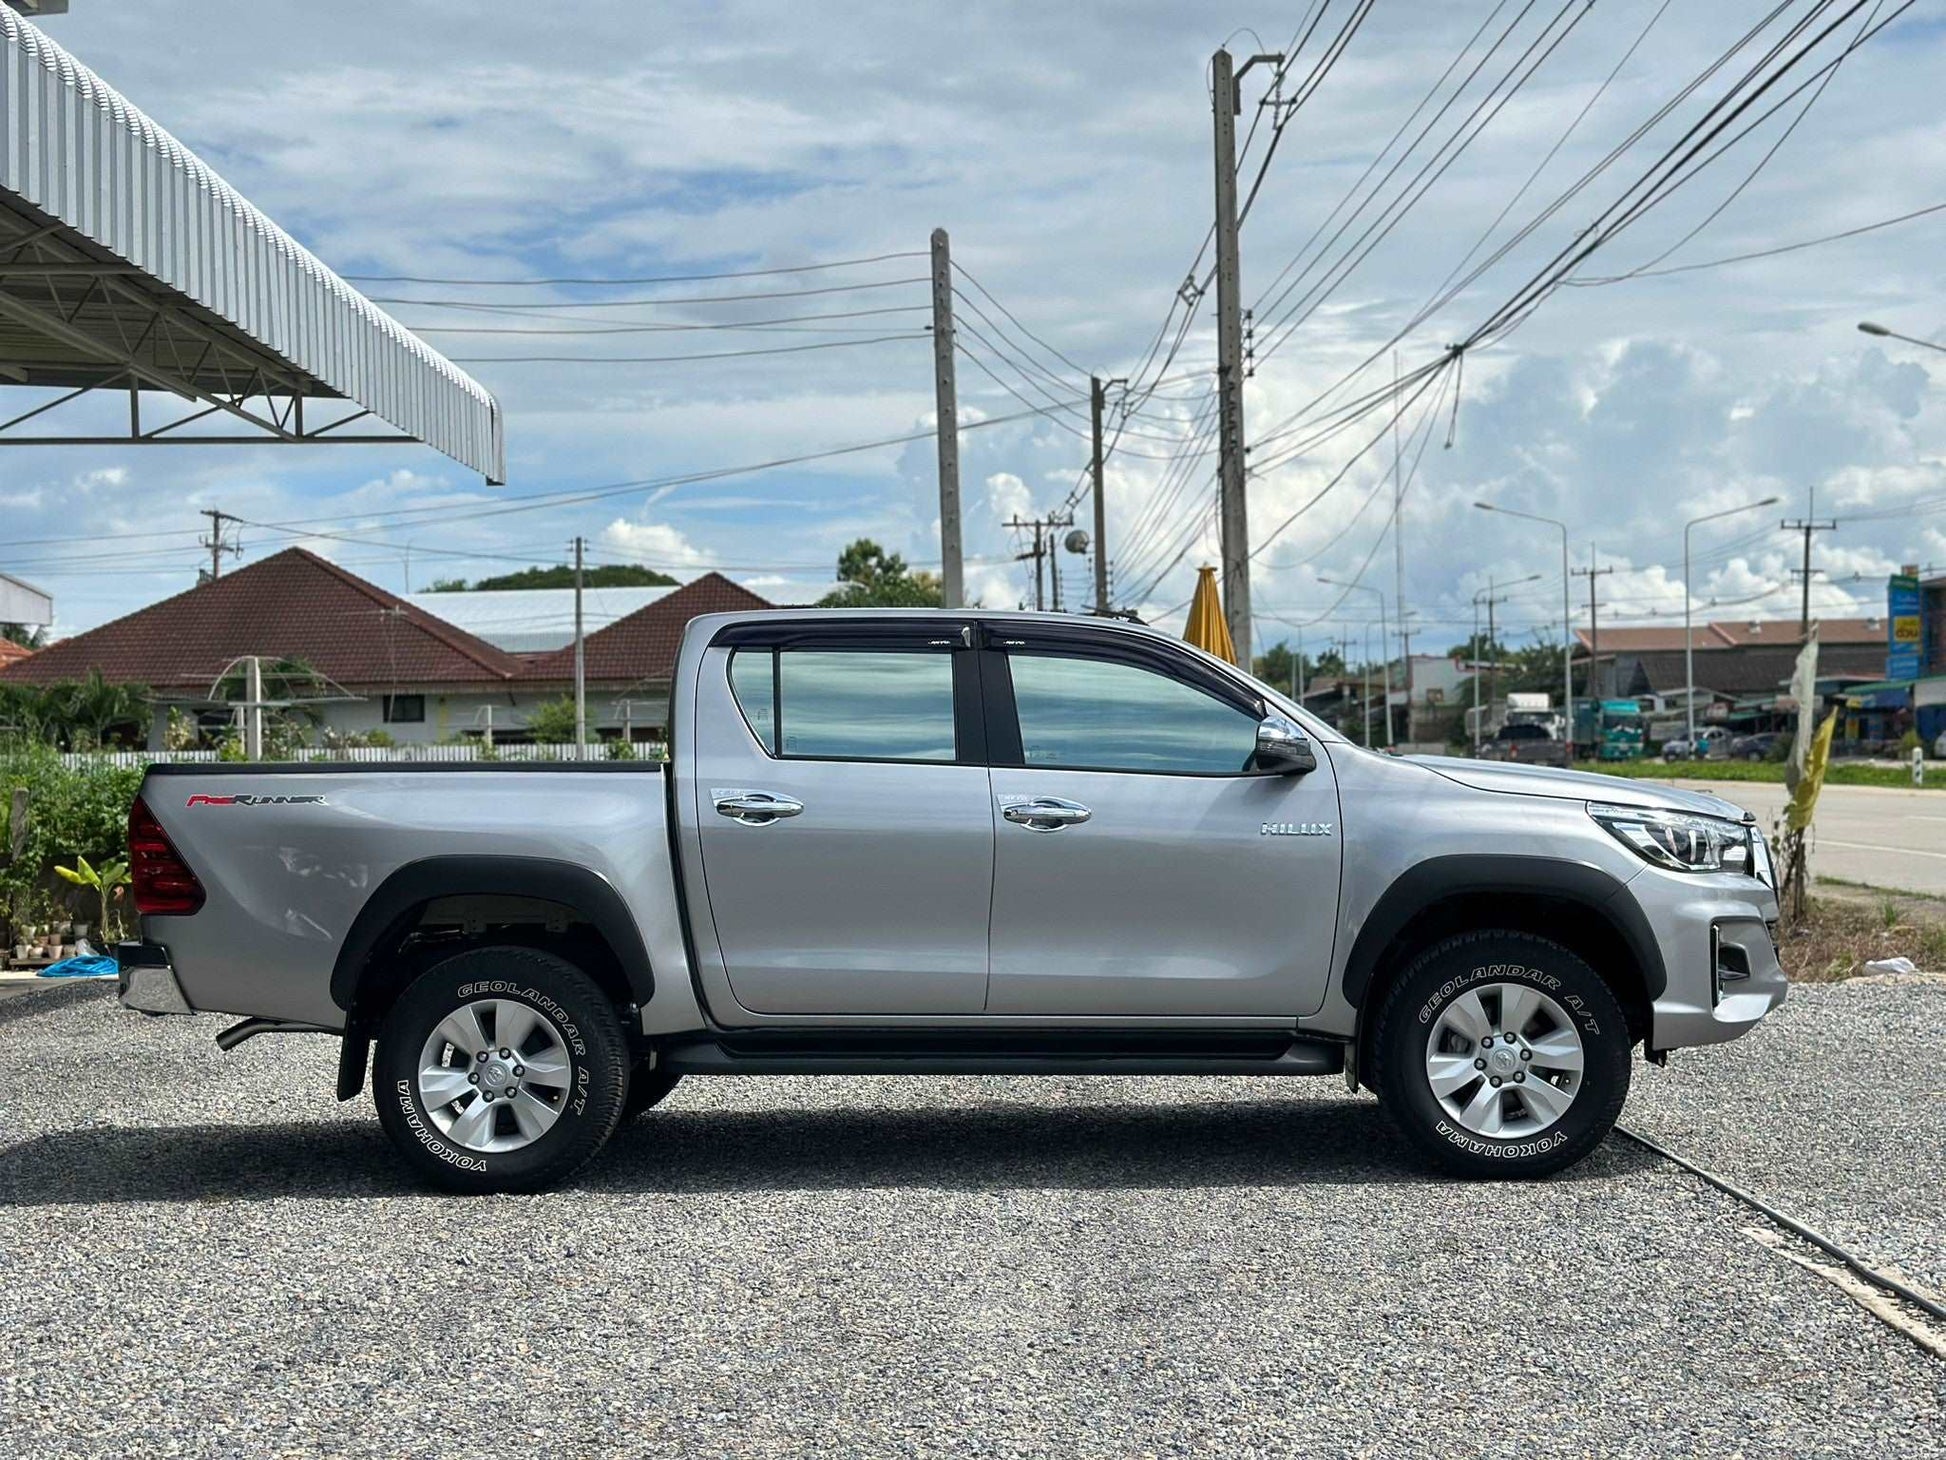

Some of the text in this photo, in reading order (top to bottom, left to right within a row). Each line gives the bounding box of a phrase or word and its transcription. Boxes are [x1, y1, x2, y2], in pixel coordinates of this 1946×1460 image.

[1260, 822, 1332, 836] HILUX
[1418, 965, 1600, 1035] GEOLANDAR A/T
[457, 980, 590, 1116] GEOLANDAR A/T
[397, 1079, 487, 1172] YOKOHAMA
[1435, 1120, 1569, 1158] YOKOHAMA
